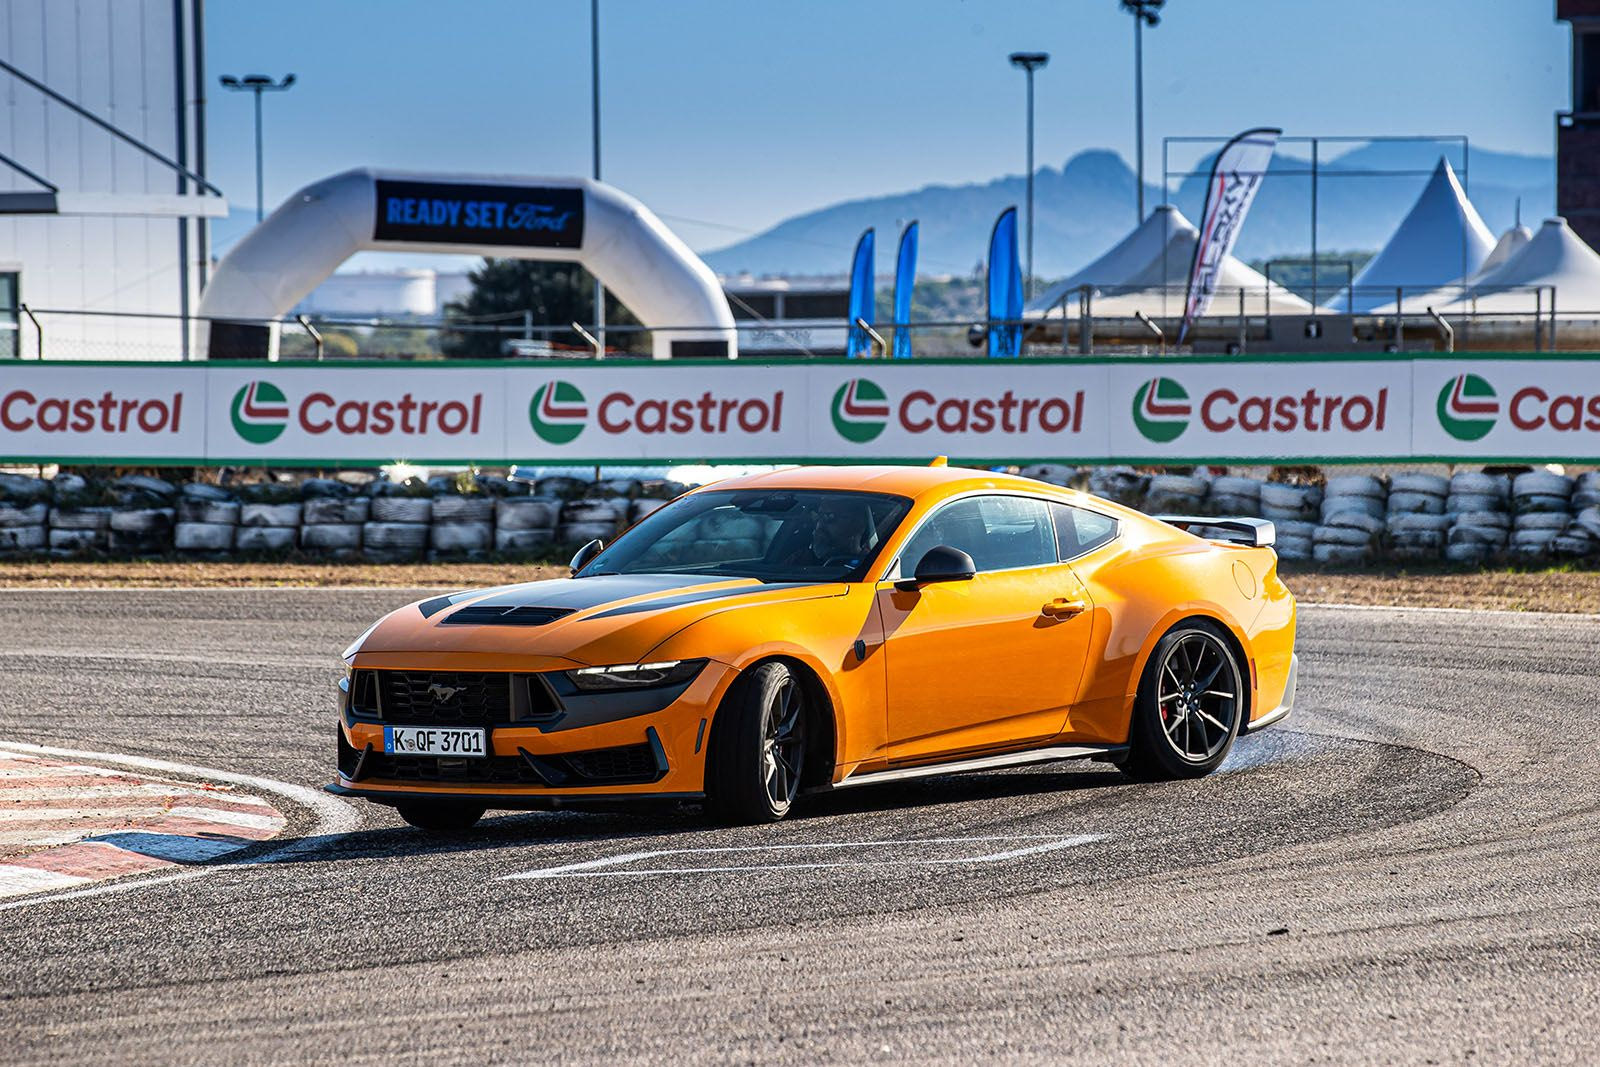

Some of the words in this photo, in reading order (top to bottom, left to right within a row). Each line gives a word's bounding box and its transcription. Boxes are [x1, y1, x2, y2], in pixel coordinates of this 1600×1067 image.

[386, 197, 462, 227] READY
[464, 201, 508, 230] SET
[507, 203, 576, 232] Ford
[1, 389, 181, 433] Castrol
[299, 393, 481, 433] Castrol
[598, 391, 782, 433] Castrol
[900, 390, 1083, 433] Castrol
[1202, 389, 1386, 432] Castrol
[394, 729, 406, 751] K
[416, 730, 437, 752] QF
[440, 731, 483, 753] 3701
